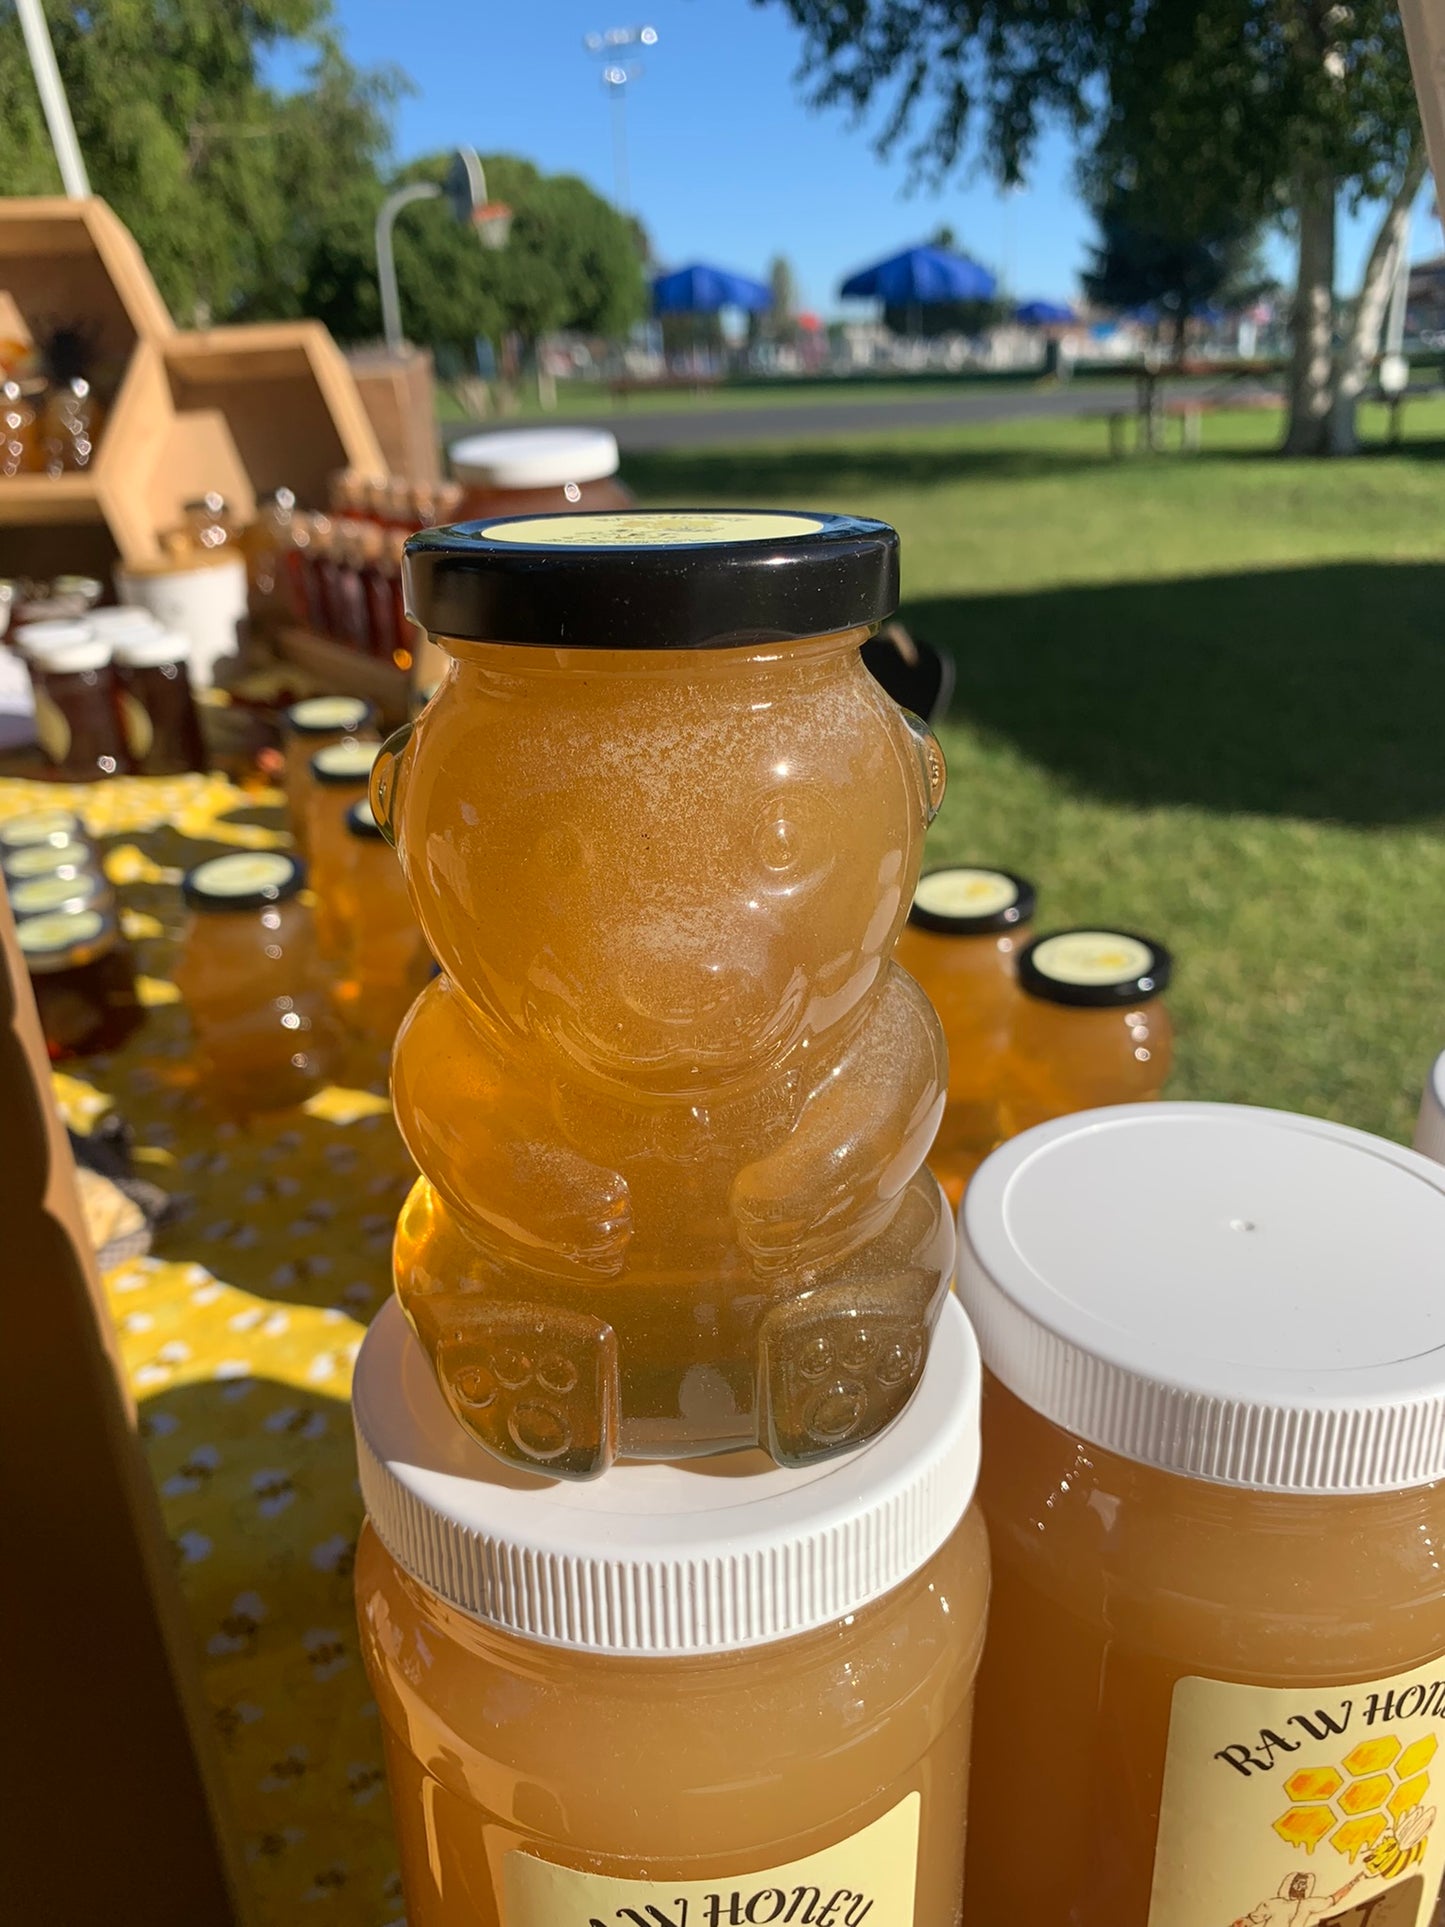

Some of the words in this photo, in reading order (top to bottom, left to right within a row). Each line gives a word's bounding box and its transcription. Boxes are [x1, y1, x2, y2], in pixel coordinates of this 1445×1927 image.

[1213, 1700, 1353, 1777] RAW
[1362, 1681, 1445, 1726] HON
[702, 1886, 874, 1927] HONEY
